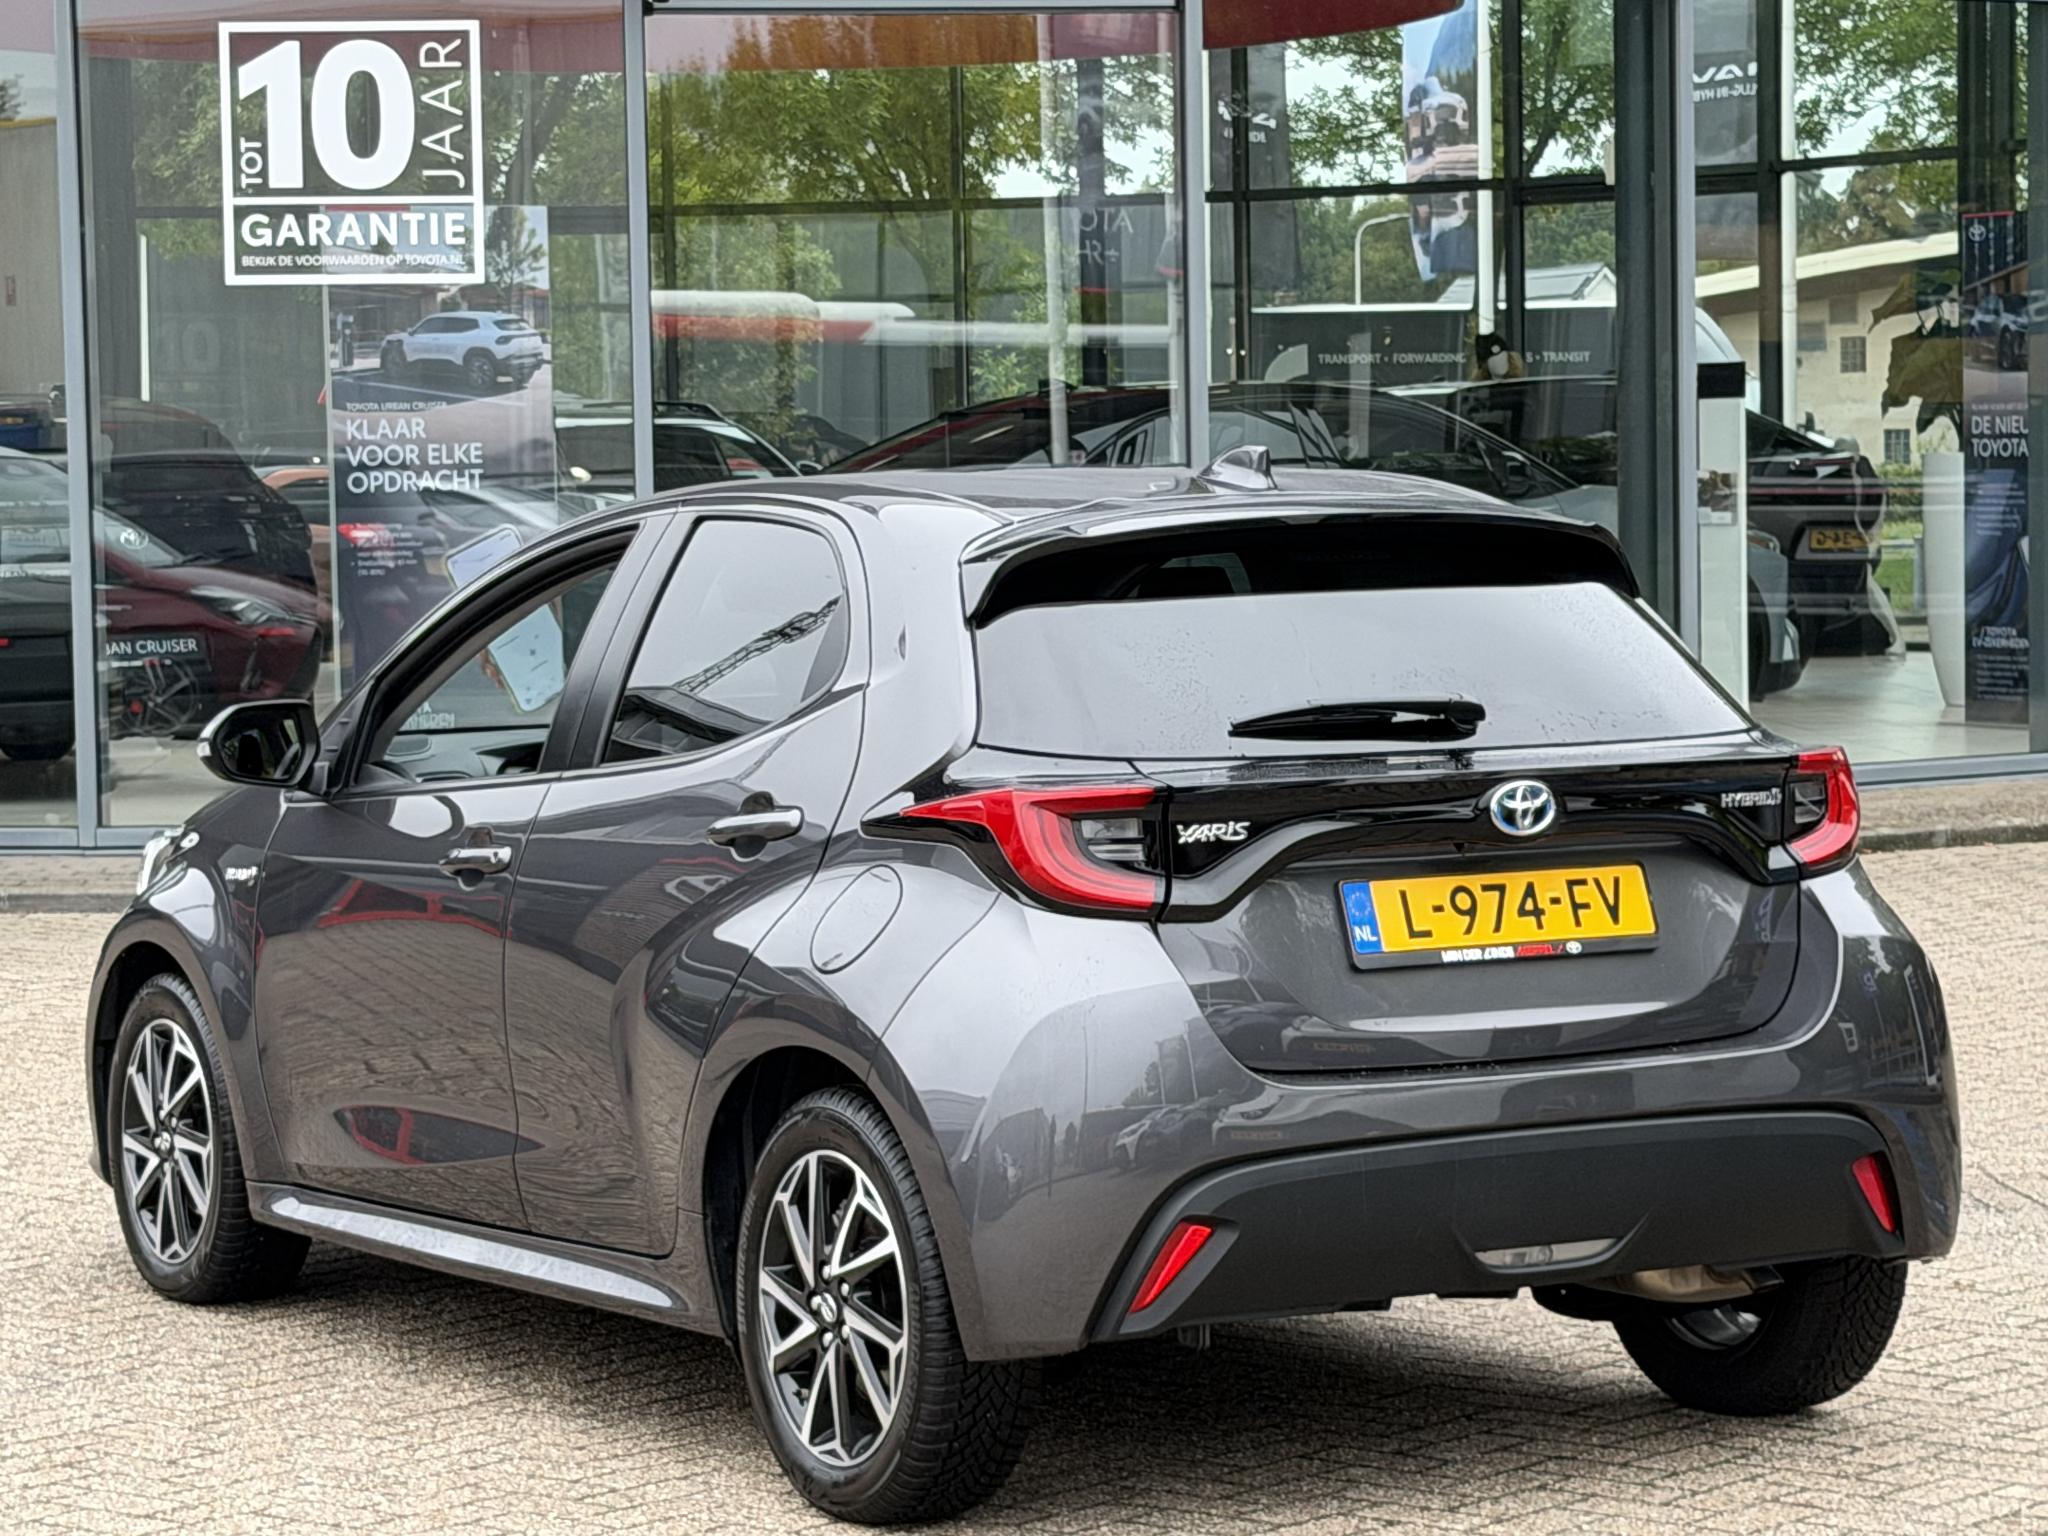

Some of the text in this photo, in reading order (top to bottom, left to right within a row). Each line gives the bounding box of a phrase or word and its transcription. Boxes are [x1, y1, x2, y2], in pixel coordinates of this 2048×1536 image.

[238, 39, 415, 190] 10
[419, 38, 466, 189] JAAR
[240, 136, 263, 189] TOT
[241, 212, 466, 247] GARANTIE
[241, 254, 466, 267] BEKIJK DE VOORWAARDEN OP TOYOTA.NL
[1318, 353, 1382, 364] TRANSPORT
[1392, 353, 1467, 364] FORWARDING
[1543, 351, 1591, 363] TRANSIT
[346, 402, 379, 411] TOYOTA
[346, 417, 427, 440] KLAAR
[1971, 415, 1992, 434] DE
[346, 442, 484, 467] VOOR ELKE
[1971, 437, 2029, 457] TOYOTA
[347, 468, 484, 493] OPDRACHT
[135, 638, 198, 654] CRUISER
[1176, 821, 1251, 844] YARIS
[1399, 875, 1620, 939] L-974-FV
[1353, 925, 1378, 942] NL
